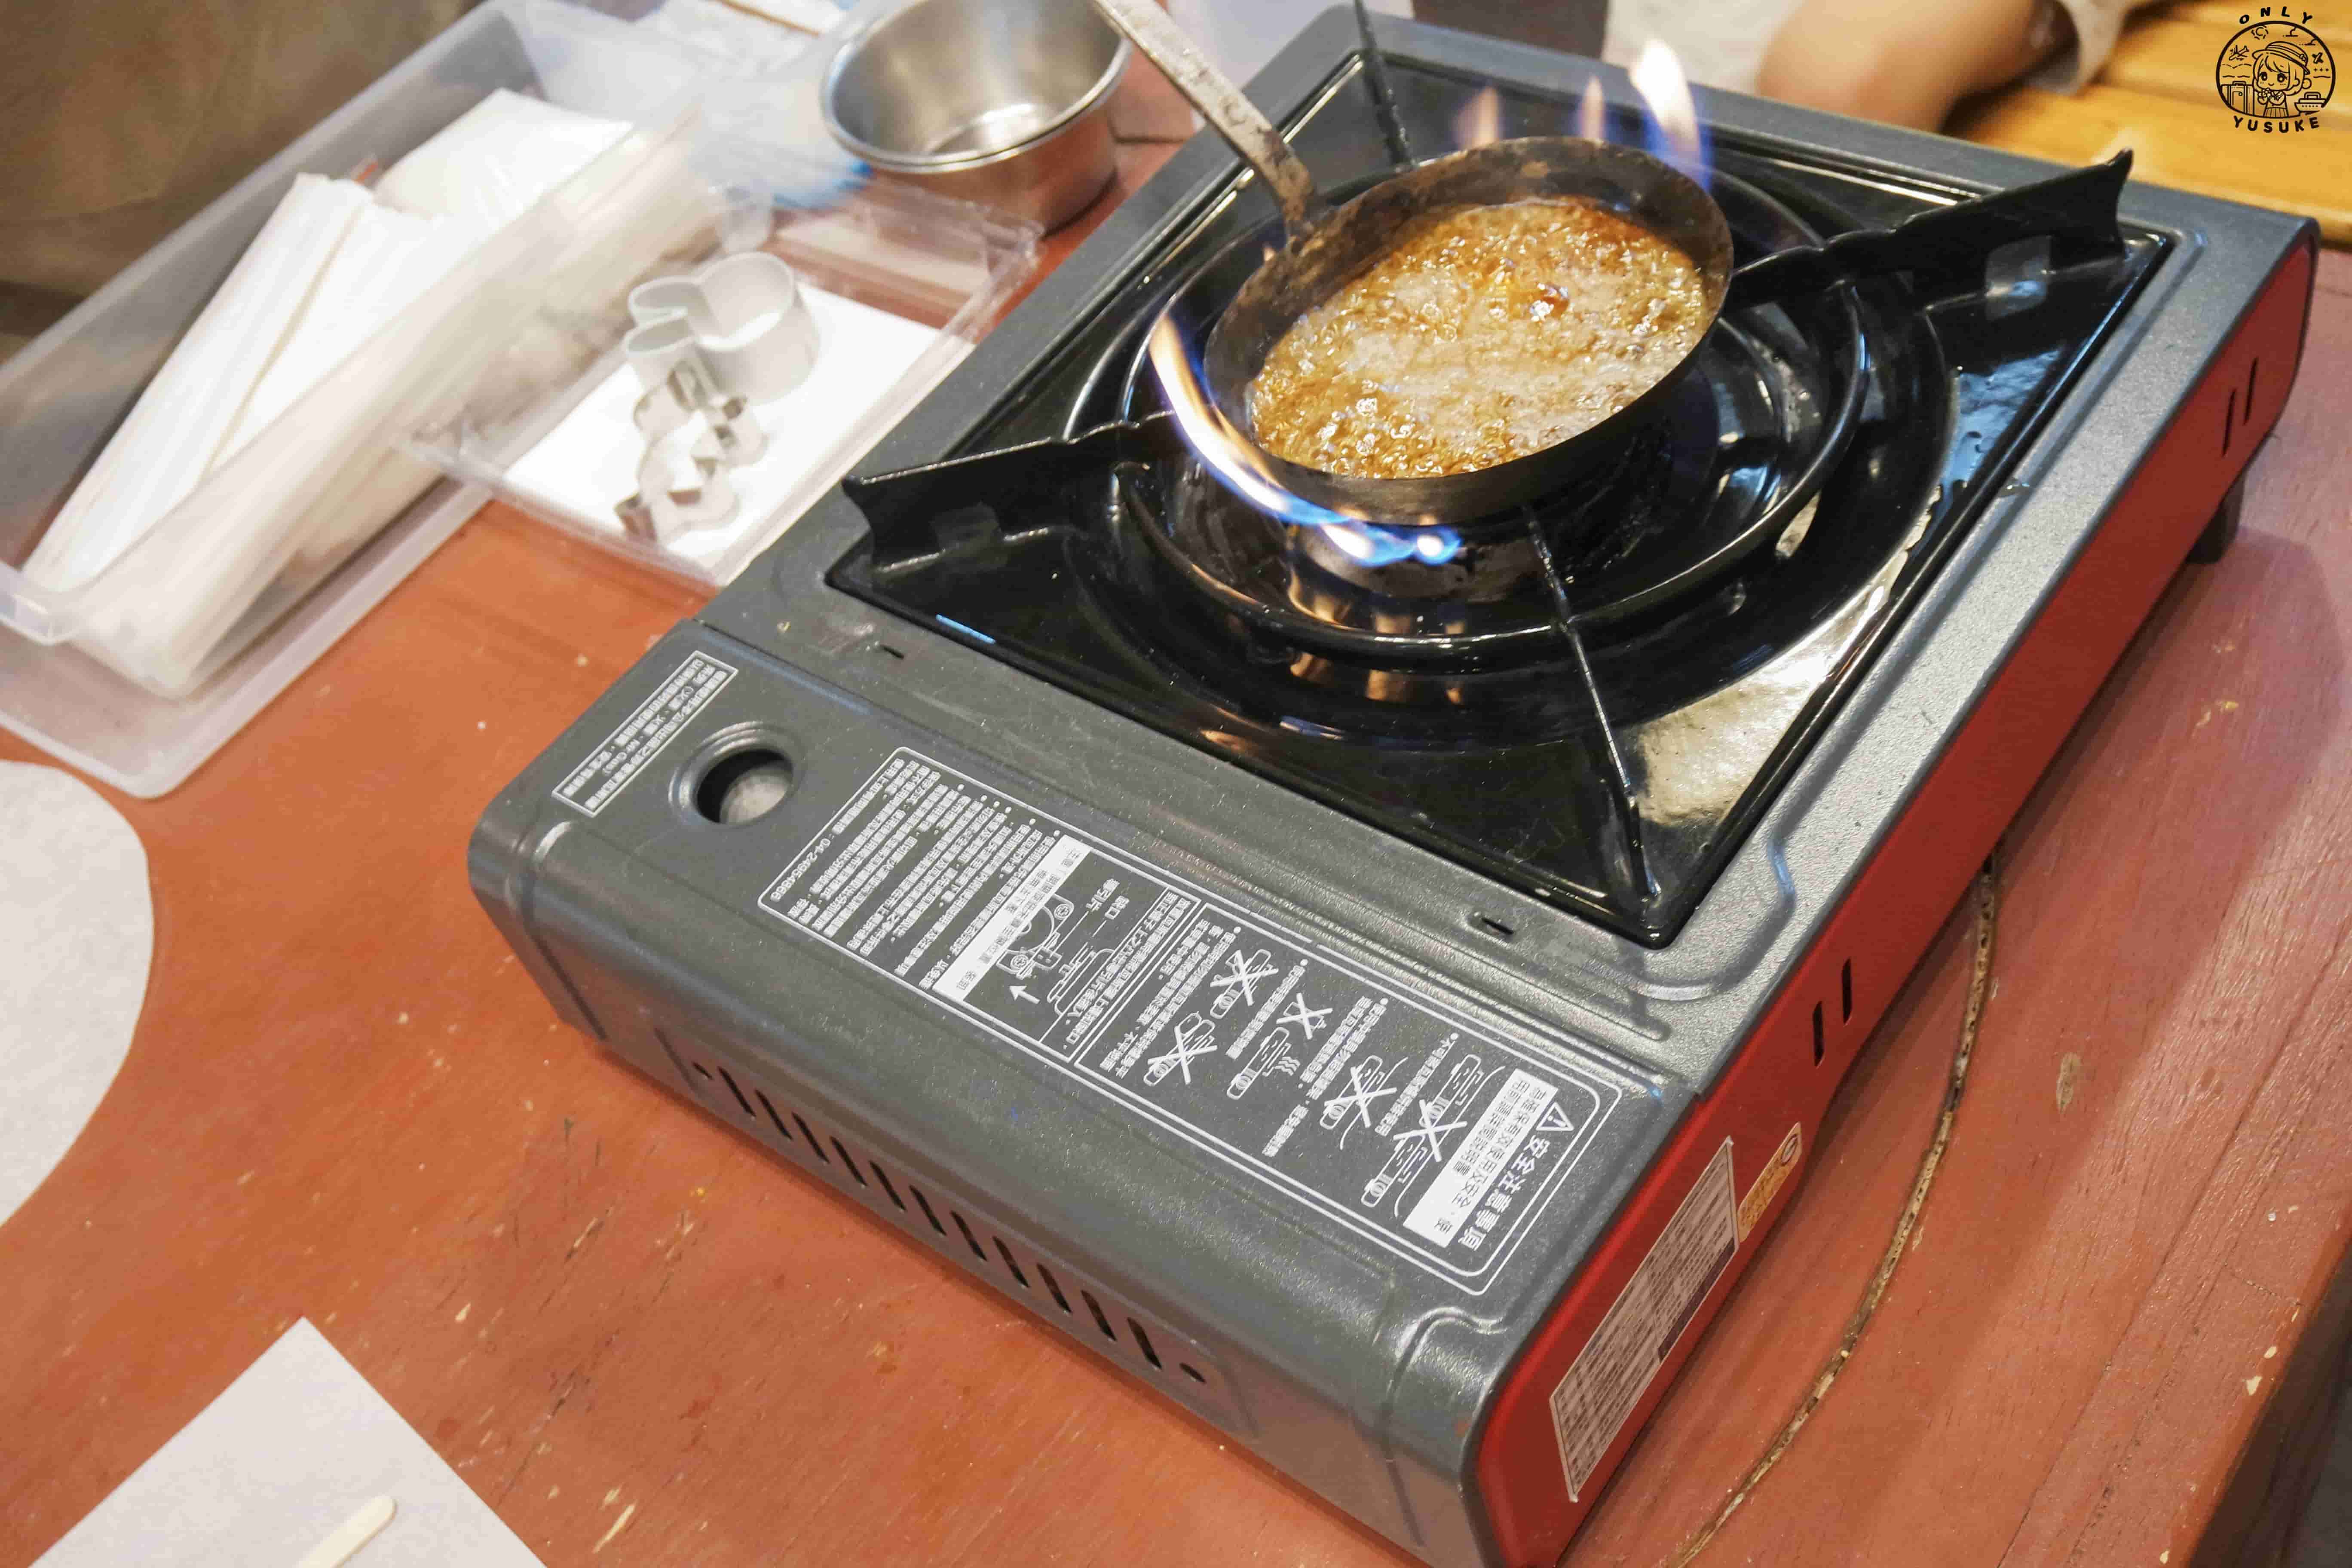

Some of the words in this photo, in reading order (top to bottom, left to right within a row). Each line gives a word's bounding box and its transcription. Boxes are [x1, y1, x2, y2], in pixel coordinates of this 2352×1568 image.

[1103, 895, 1130, 920] 缺口
[1431, 1085, 1550, 1235] 為確保有效使用及安全，使
[1456, 1133, 1553, 1252] 安全注意事項
